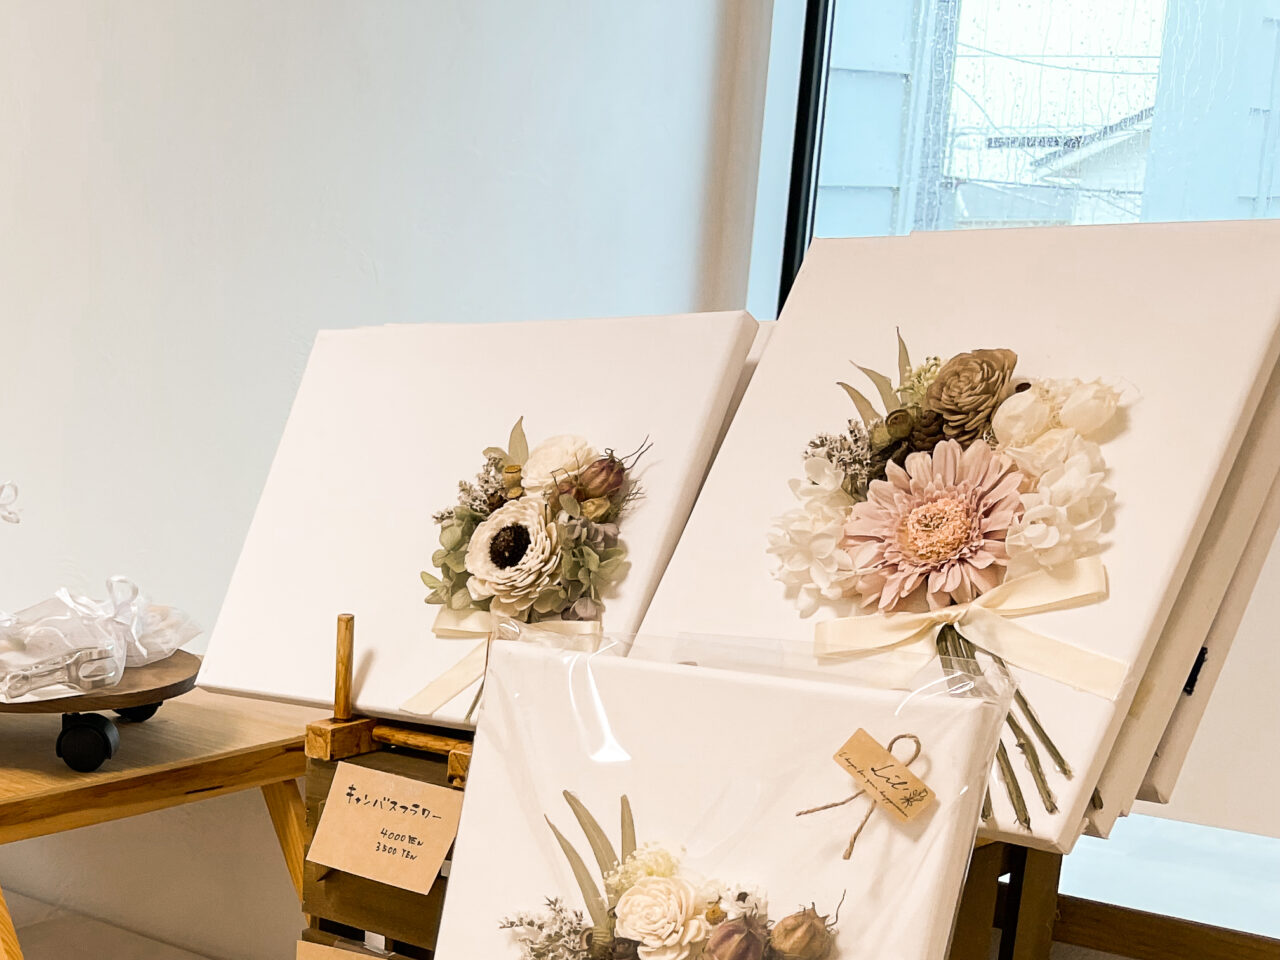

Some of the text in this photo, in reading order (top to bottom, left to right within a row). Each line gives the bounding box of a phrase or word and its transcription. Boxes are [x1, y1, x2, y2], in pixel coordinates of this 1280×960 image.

[345, 784, 443, 819] キャンバスフラワー
